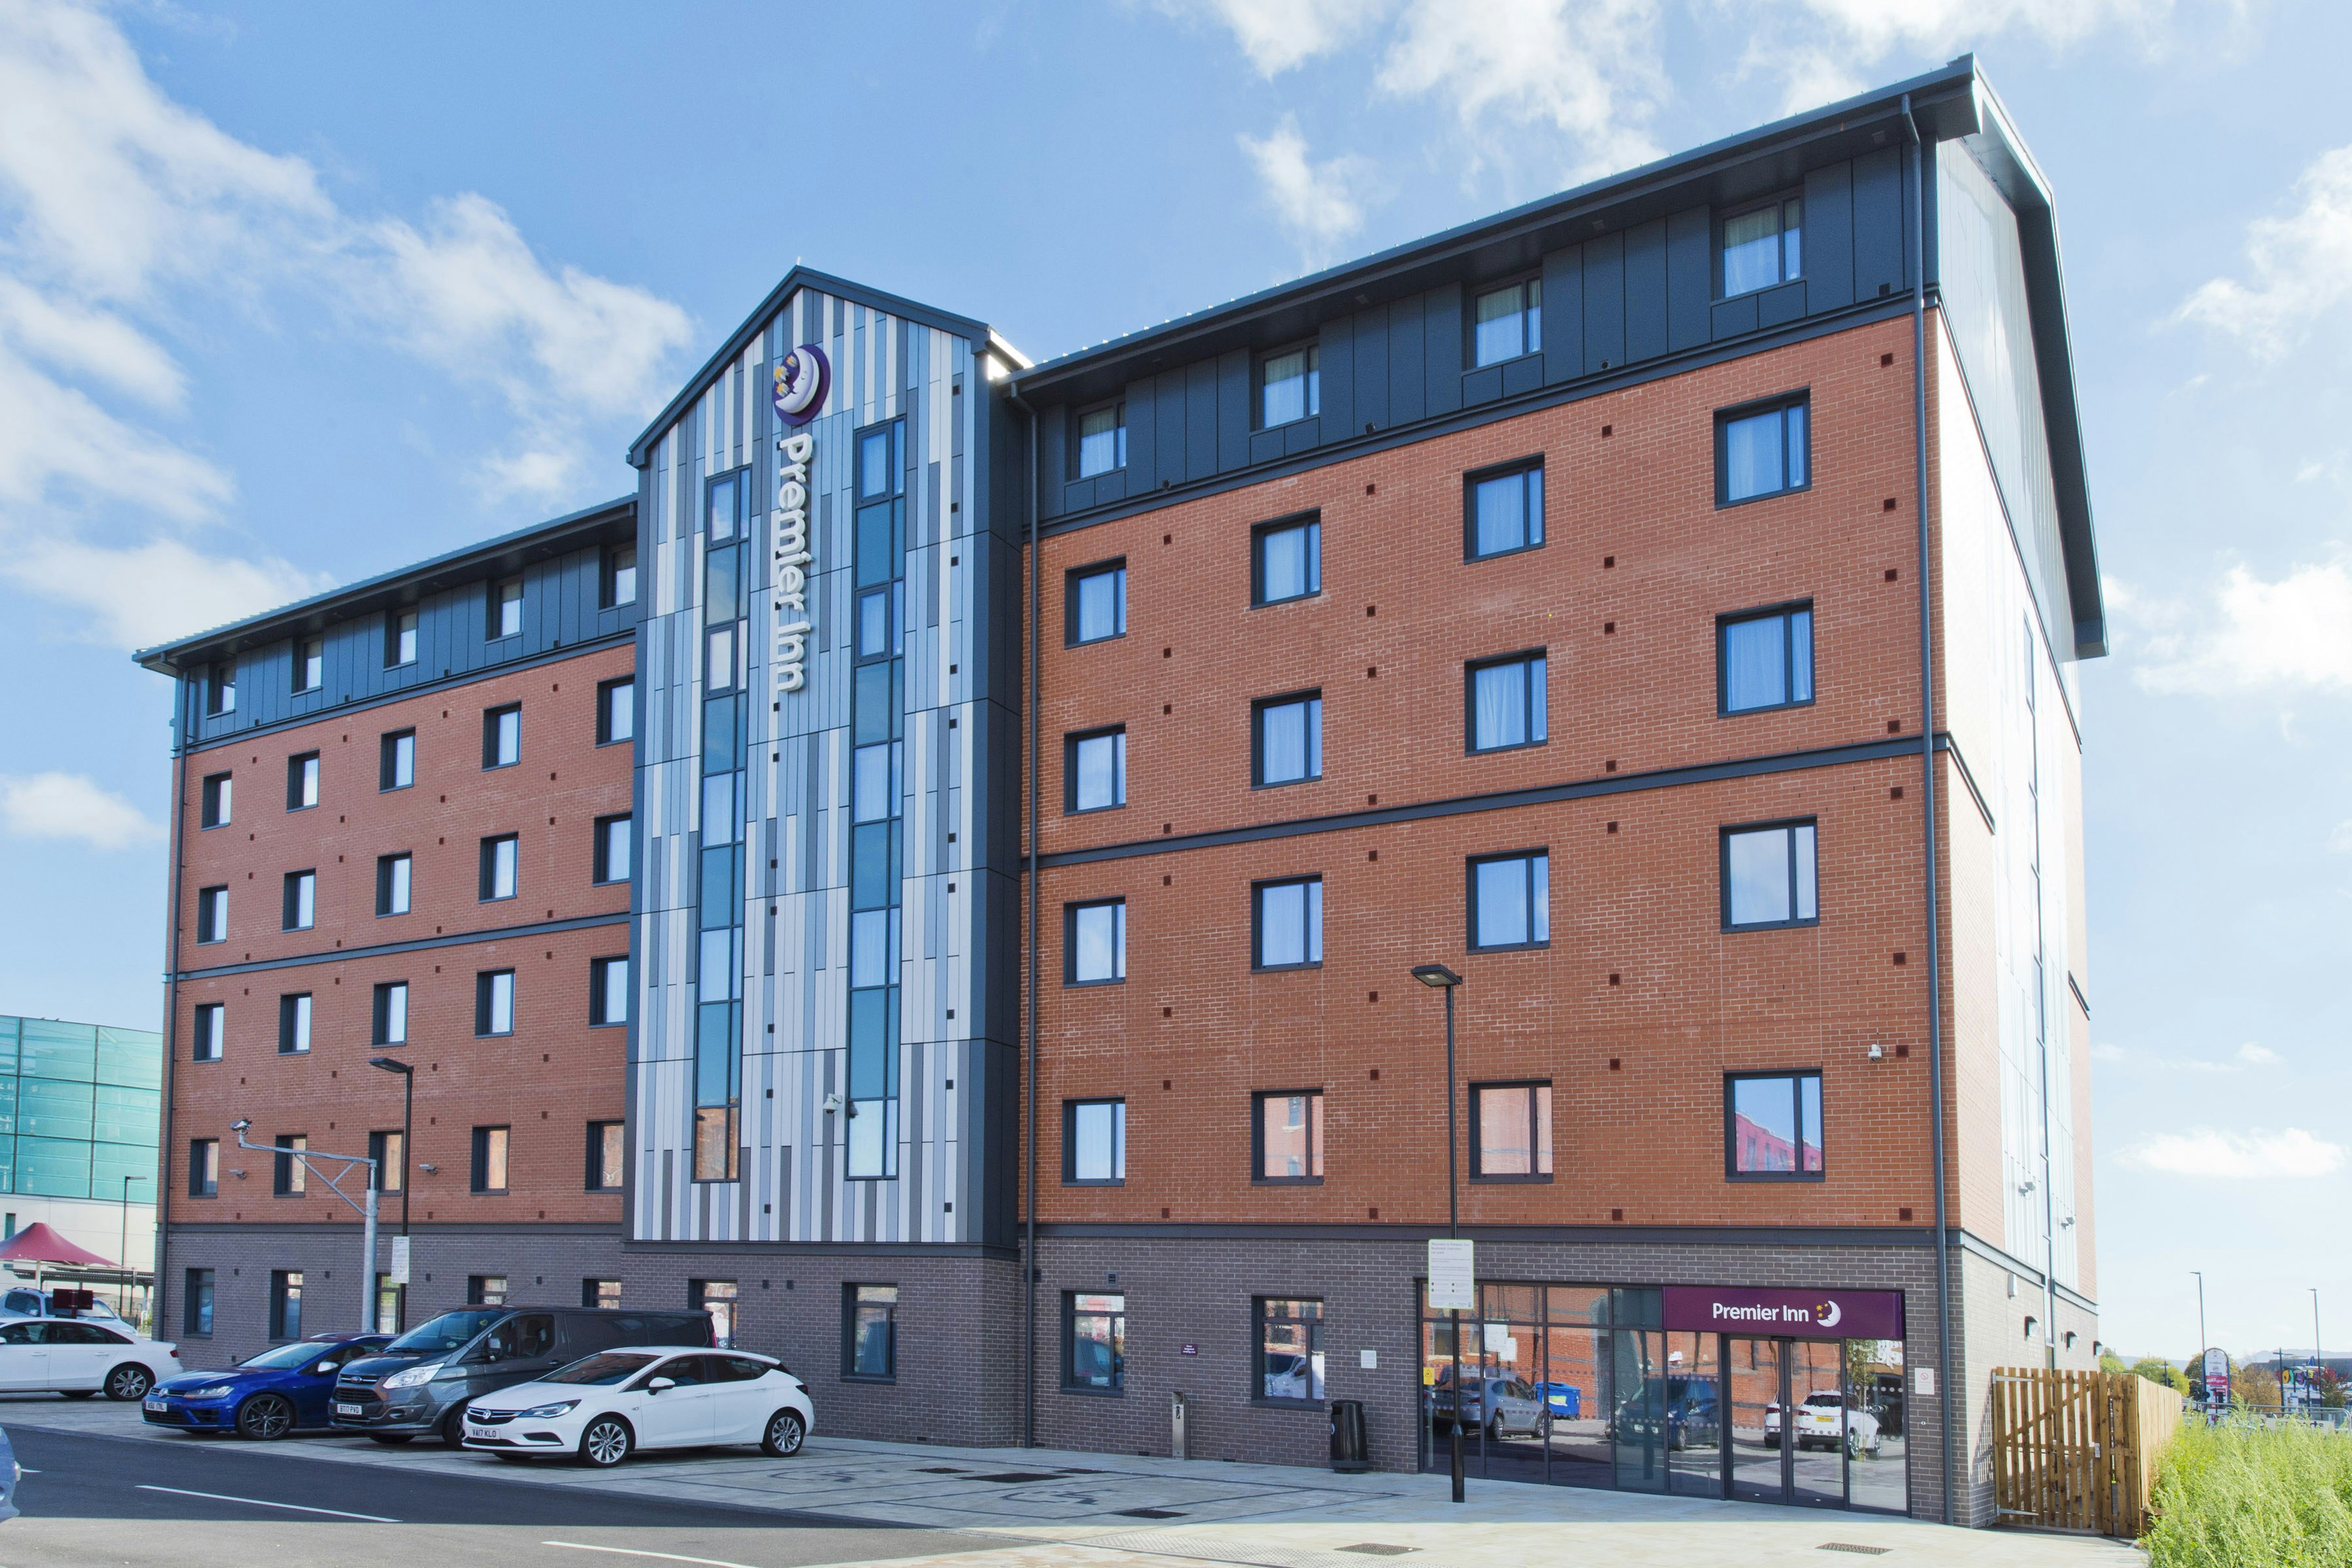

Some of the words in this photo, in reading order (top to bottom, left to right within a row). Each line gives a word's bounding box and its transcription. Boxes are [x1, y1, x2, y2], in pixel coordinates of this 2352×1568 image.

[777, 433, 813, 612] Premier
[777, 621, 811, 693] Inn
[1712, 1302, 1779, 1320] Premier
[1783, 1305, 1809, 1322] Inn
